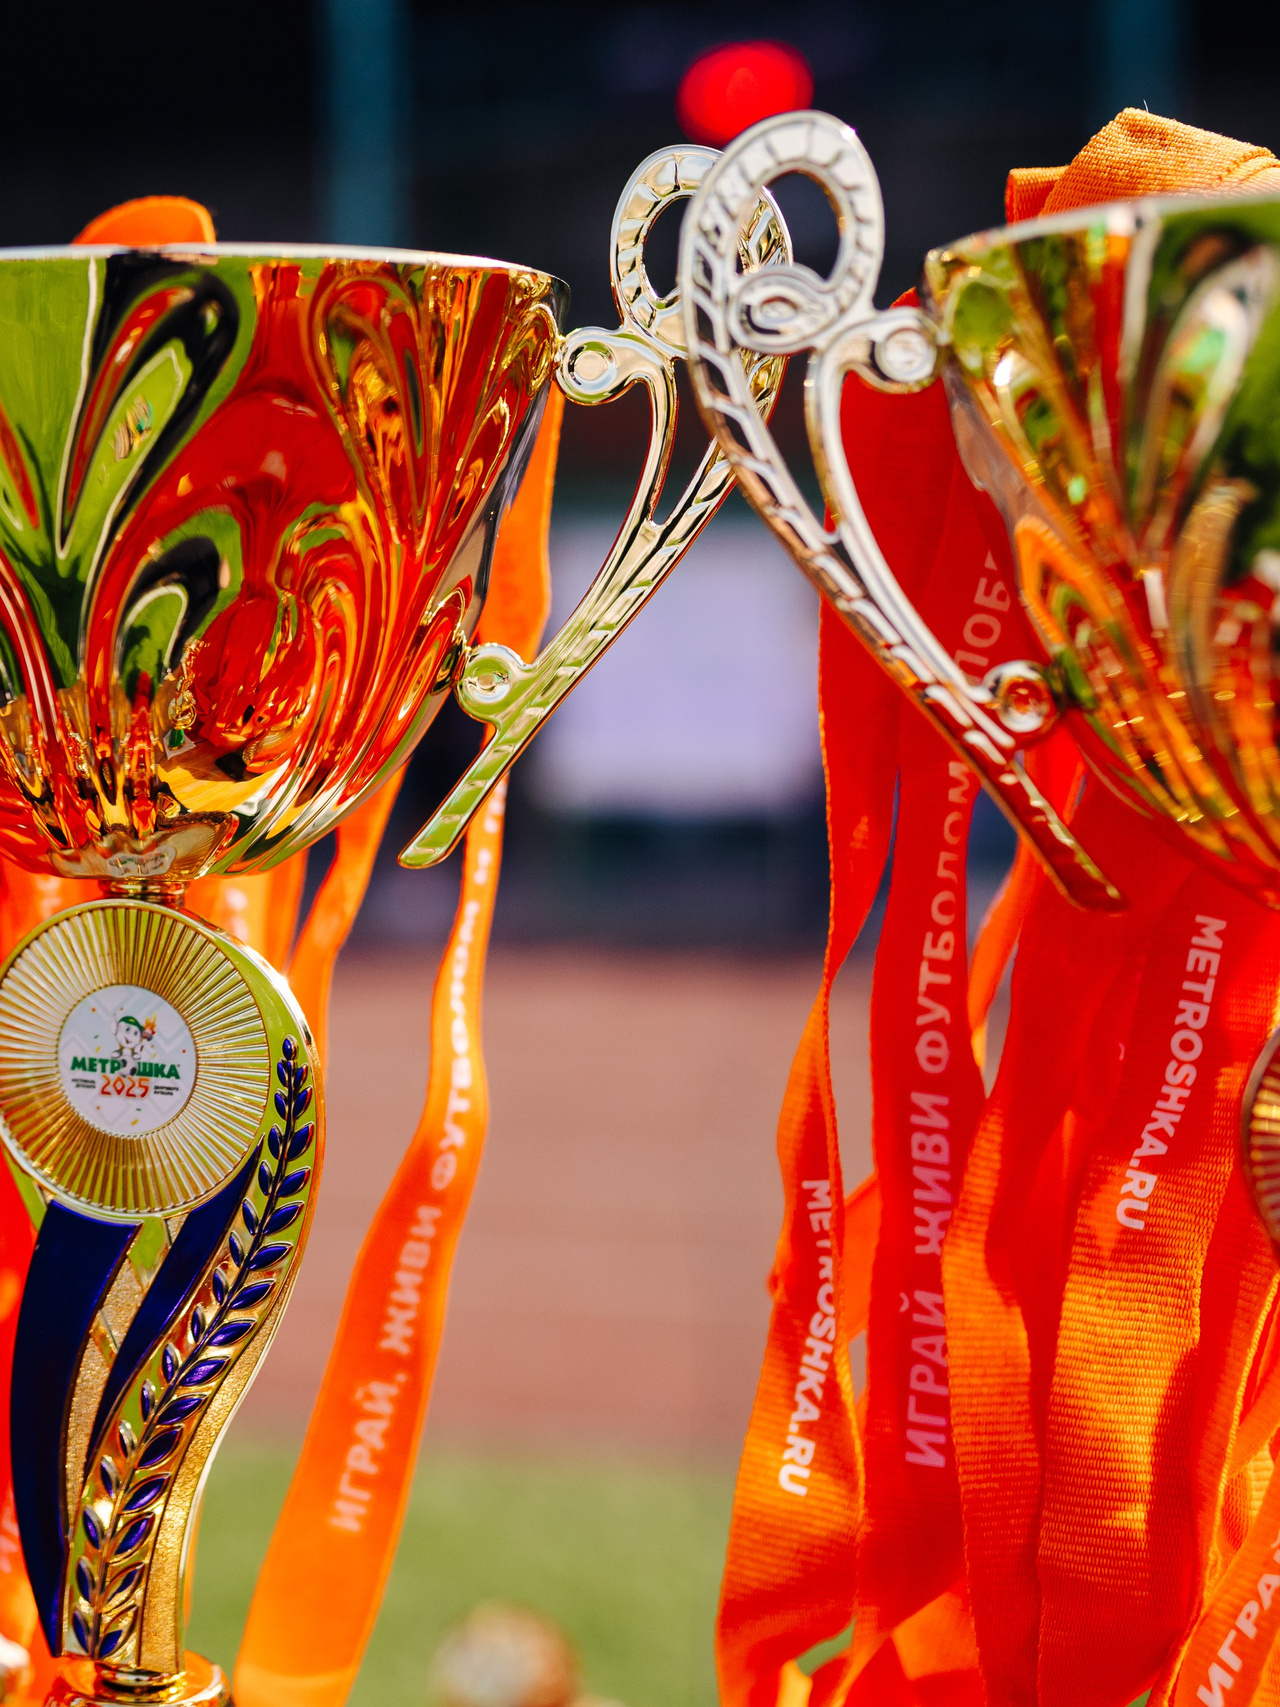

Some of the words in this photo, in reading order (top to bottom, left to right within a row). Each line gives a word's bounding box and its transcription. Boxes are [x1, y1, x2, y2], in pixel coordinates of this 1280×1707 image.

[915, 760, 970, 1075] ФУТБОЛОМ
[100, 1074, 150, 1099] 2025
[1116, 914, 1227, 1231] METROSHKA.RU
[910, 1091, 952, 1255] ЖИВИ
[379, 1204, 442, 1356] ЖИВИ
[1196, 1528, 1280, 1707] ИГРА
